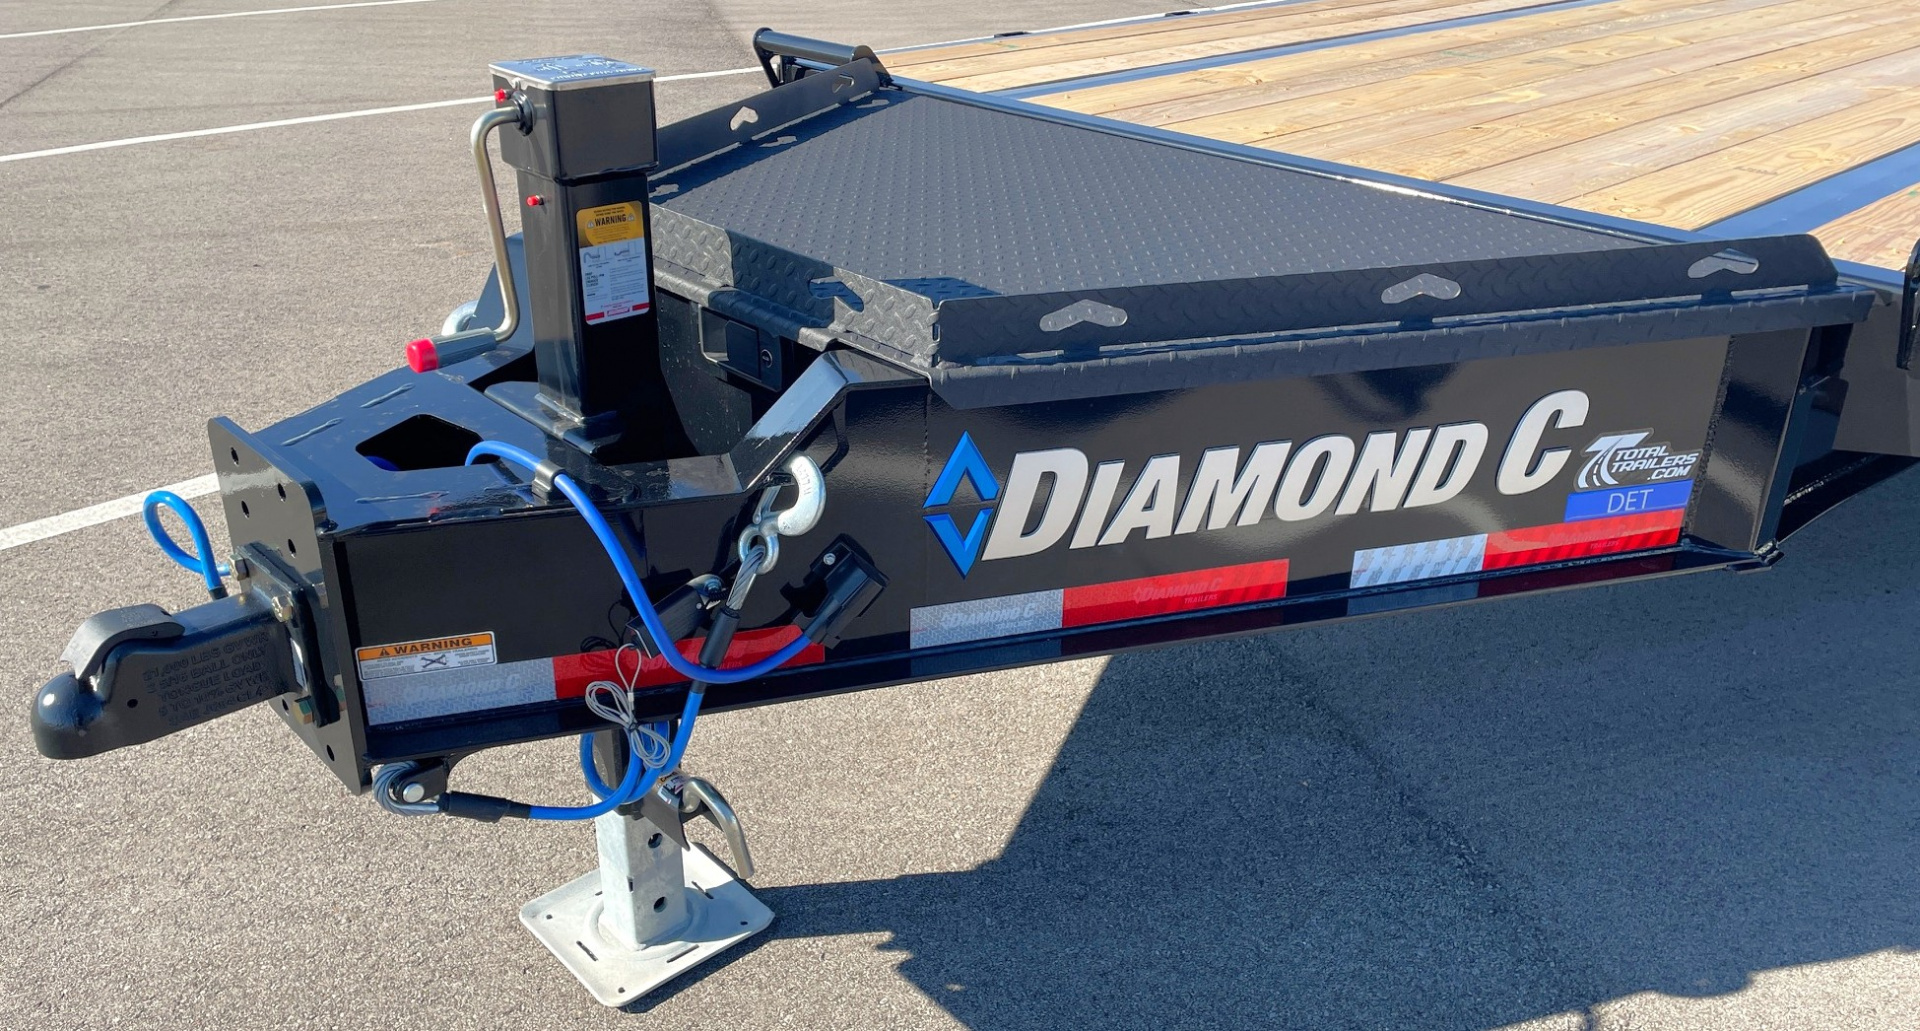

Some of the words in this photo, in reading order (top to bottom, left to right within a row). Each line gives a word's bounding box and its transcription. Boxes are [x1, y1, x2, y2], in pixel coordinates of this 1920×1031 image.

[595, 214, 627, 226] WARNING
[1615, 446, 1669, 461] TOTAL
[1611, 453, 1699, 473] TRAILERS
[981, 420, 1489, 562] DIAMOND
[1496, 389, 1590, 496] C
[1647, 465, 1691, 480] .COM
[1607, 489, 1654, 514] DET
[1184, 594, 1218, 604] TRAILERS
[394, 638, 473, 655] WARNING
